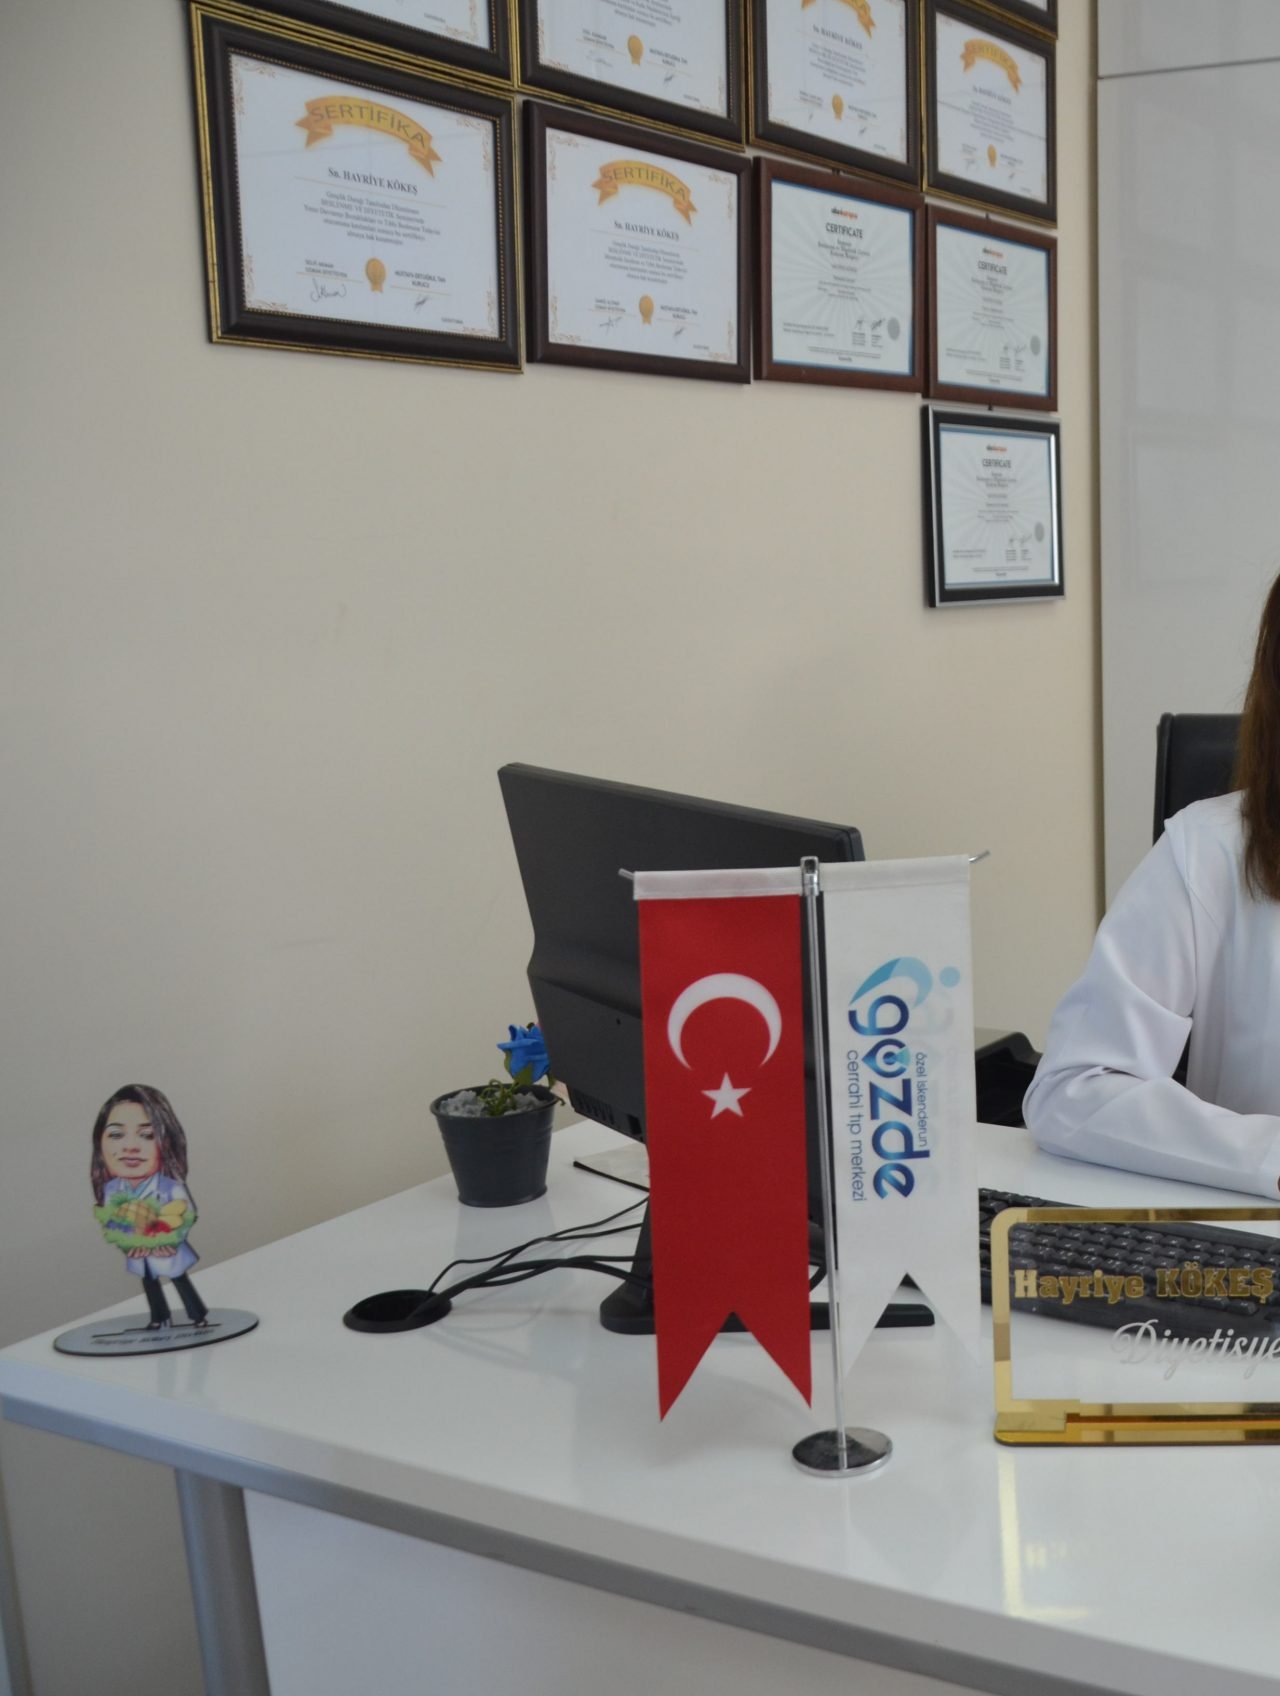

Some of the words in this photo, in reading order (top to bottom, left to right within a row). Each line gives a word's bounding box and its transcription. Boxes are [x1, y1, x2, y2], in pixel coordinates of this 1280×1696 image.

[309, 103, 426, 147] SERTİFİKA
[343, 170, 385, 188] HAYRİYE
[385, 174, 418, 195] KÖKEŞ
[602, 165, 687, 201] SERTİFİKA
[825, 222, 863, 239] CERTIFICATE
[847, 1049, 864, 1110] cerrahi
[851, 1138, 868, 1202] merkezi
[1013, 1268, 1145, 1305] Hayriye
[1156, 1261, 1274, 1304] KÖKEŞ
